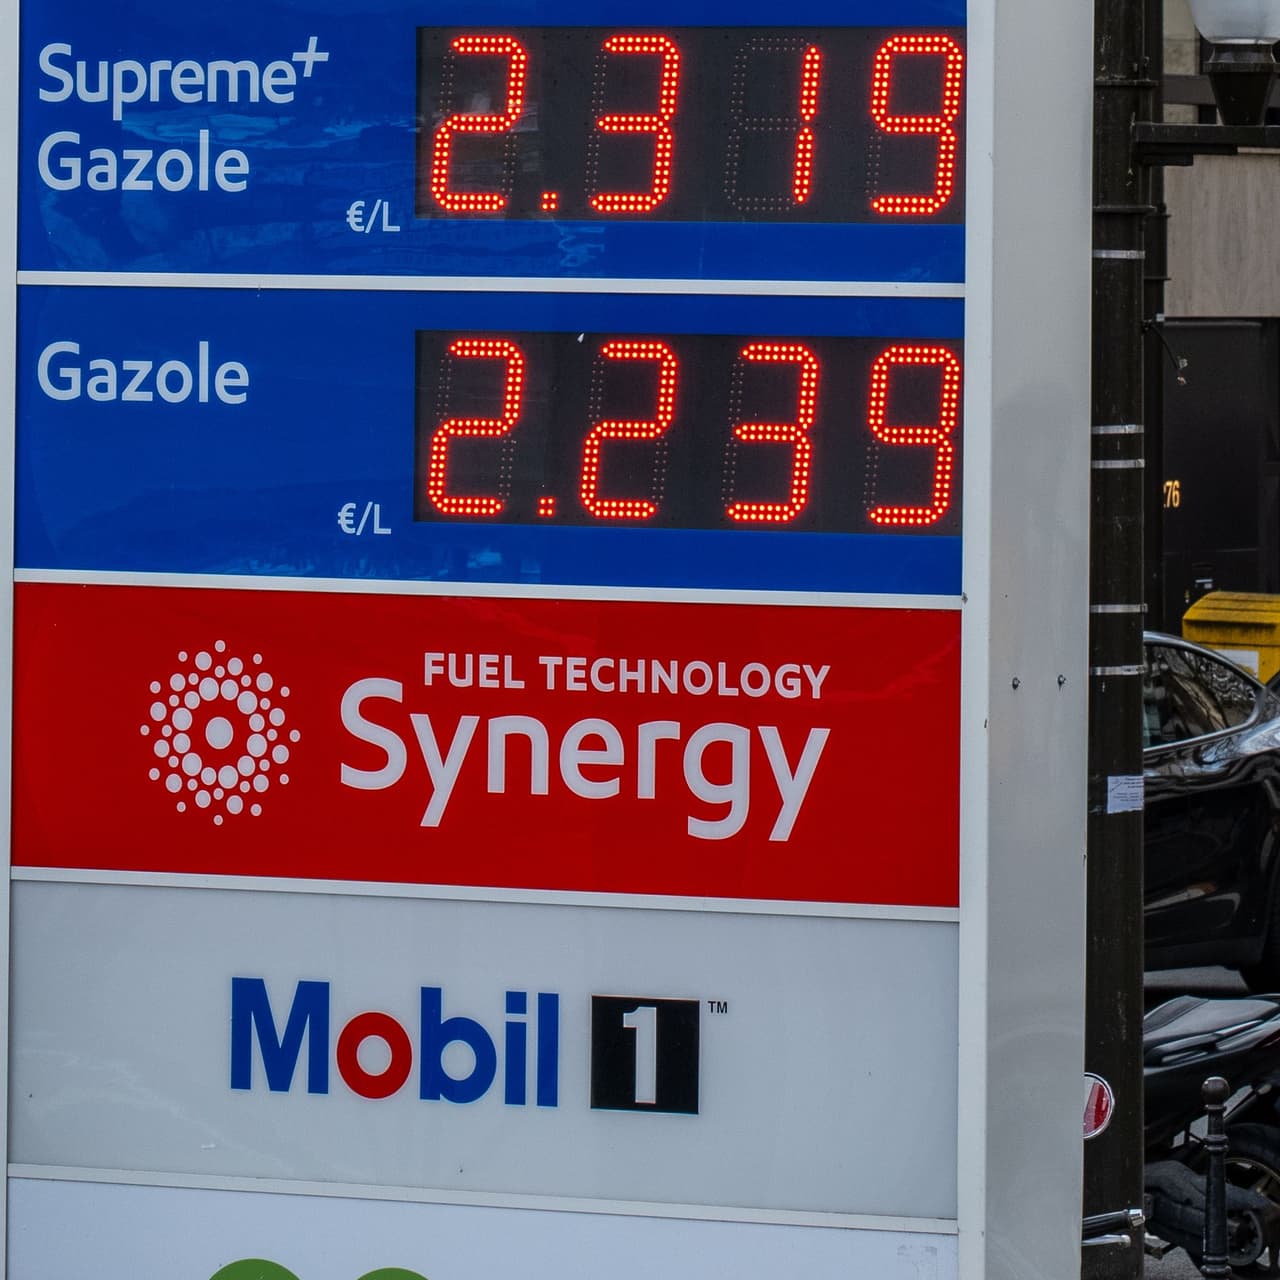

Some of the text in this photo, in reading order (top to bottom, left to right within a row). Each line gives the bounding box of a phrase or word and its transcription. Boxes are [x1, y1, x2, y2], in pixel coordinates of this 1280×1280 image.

[430, 34, 965, 216] 2.319
[37, 129, 250, 193] Gazole
[346, 199, 401, 233] €/L
[37, 340, 250, 405] Gazole
[426, 338, 963, 526] 2.239
[337, 502, 392, 536] €/L
[1163, 480, 1180, 508] 76
[424, 652, 831, 700] FUEL TECHNOLOGY
[340, 677, 831, 842] Synergy
[231, 978, 560, 1109] Mobil
[621, 1006, 658, 1105] 1
